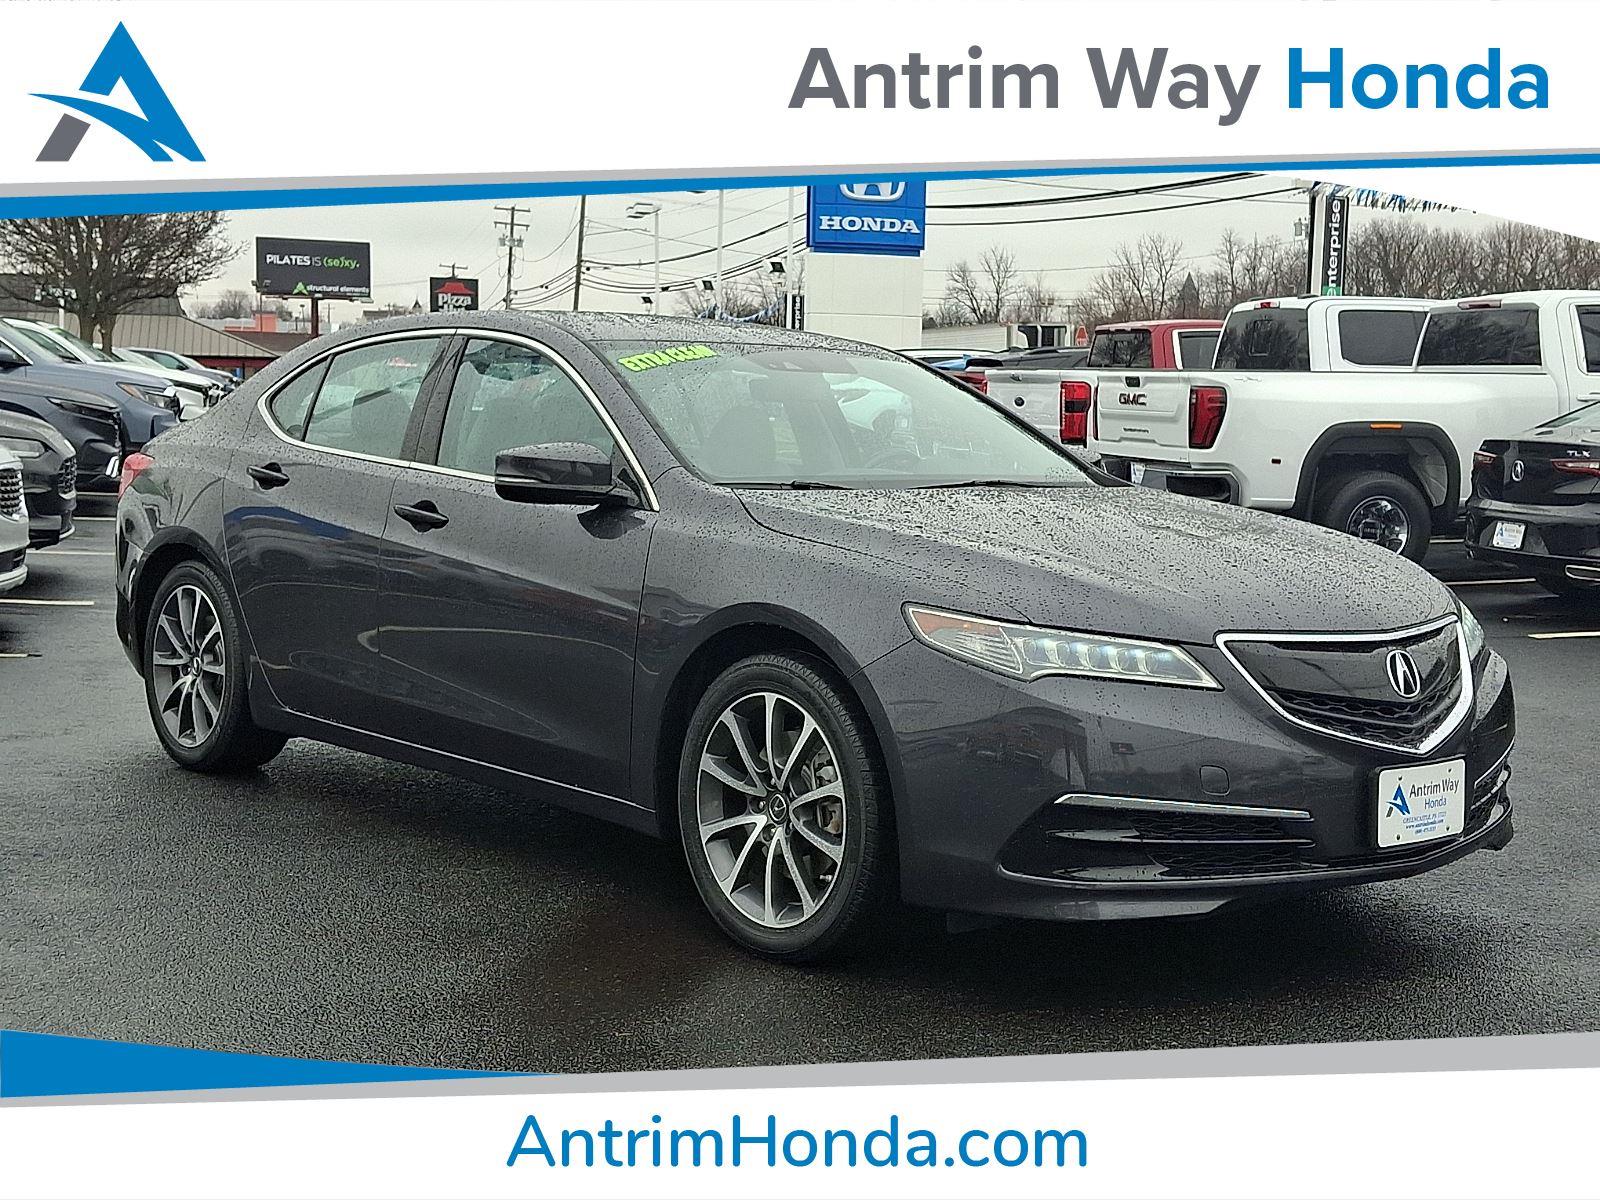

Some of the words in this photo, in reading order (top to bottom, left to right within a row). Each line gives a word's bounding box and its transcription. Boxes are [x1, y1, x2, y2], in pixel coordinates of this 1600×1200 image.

[819, 216, 921, 234] HONDA
[266, 254, 311, 266] PILATES
[312, 257, 321, 266] IS
[306, 284, 339, 292] structural
[438, 293, 472, 307] Pizza
[1119, 393, 1147, 406] GMC
[1567, 450, 1590, 458] TLX
[1409, 781, 1440, 798] Antrim
[1442, 778, 1459, 793] Way
[1424, 795, 1446, 809] Honda
